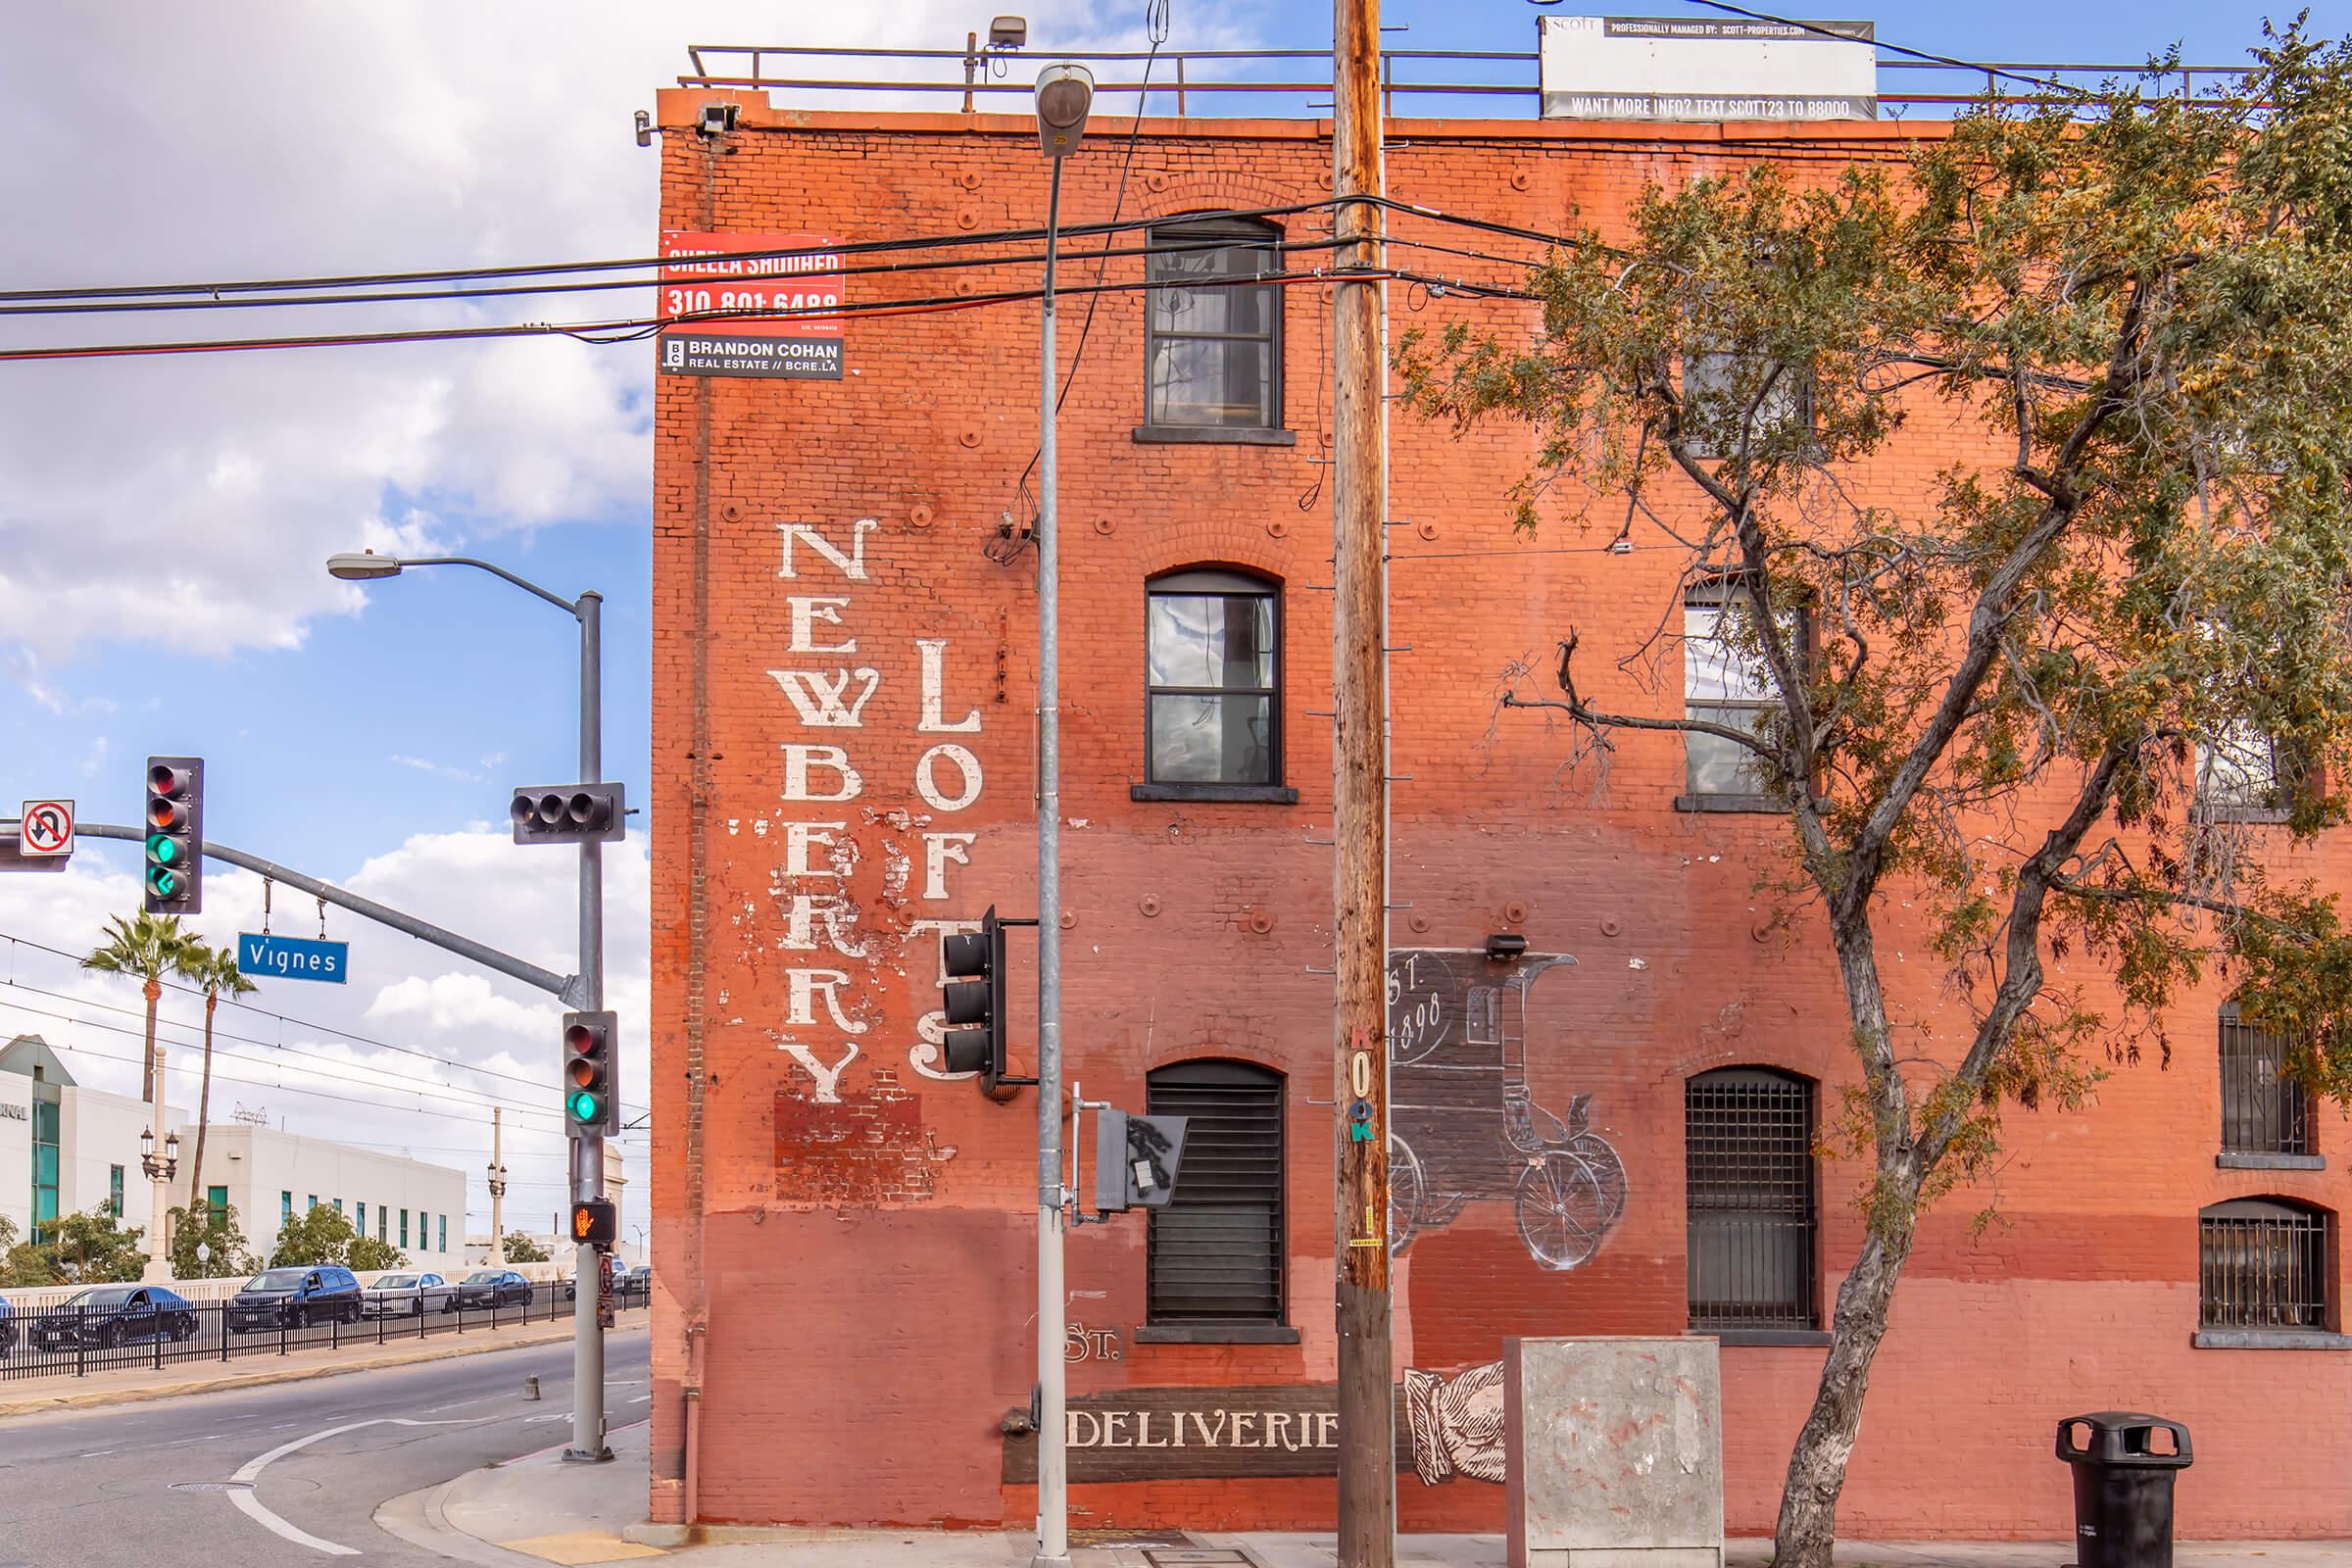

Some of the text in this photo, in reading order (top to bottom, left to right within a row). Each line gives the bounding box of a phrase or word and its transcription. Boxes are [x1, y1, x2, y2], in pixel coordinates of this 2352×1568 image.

[1612, 23, 1805, 35] PROFESSIONALLY MANAGED BY: SCOTT-PROPERTIES.COM
[1571, 97, 1849, 117] WANT MORE INFO? TEXT SCOTT23 TO 88000
[689, 340, 838, 359] BRANDON COHAN
[689, 359, 720, 369] REAL
[723, 359, 769, 370] ESTATE
[785, 361, 837, 372] BCRE.LA
[766, 518, 879, 1103] NEWBERRY
[250, 940, 336, 973] Vignes
[1390, 992, 1440, 1060] 1898
[1065, 1323, 1119, 1363] ST.
[1065, 1409, 1339, 1451] DELIVERIE
